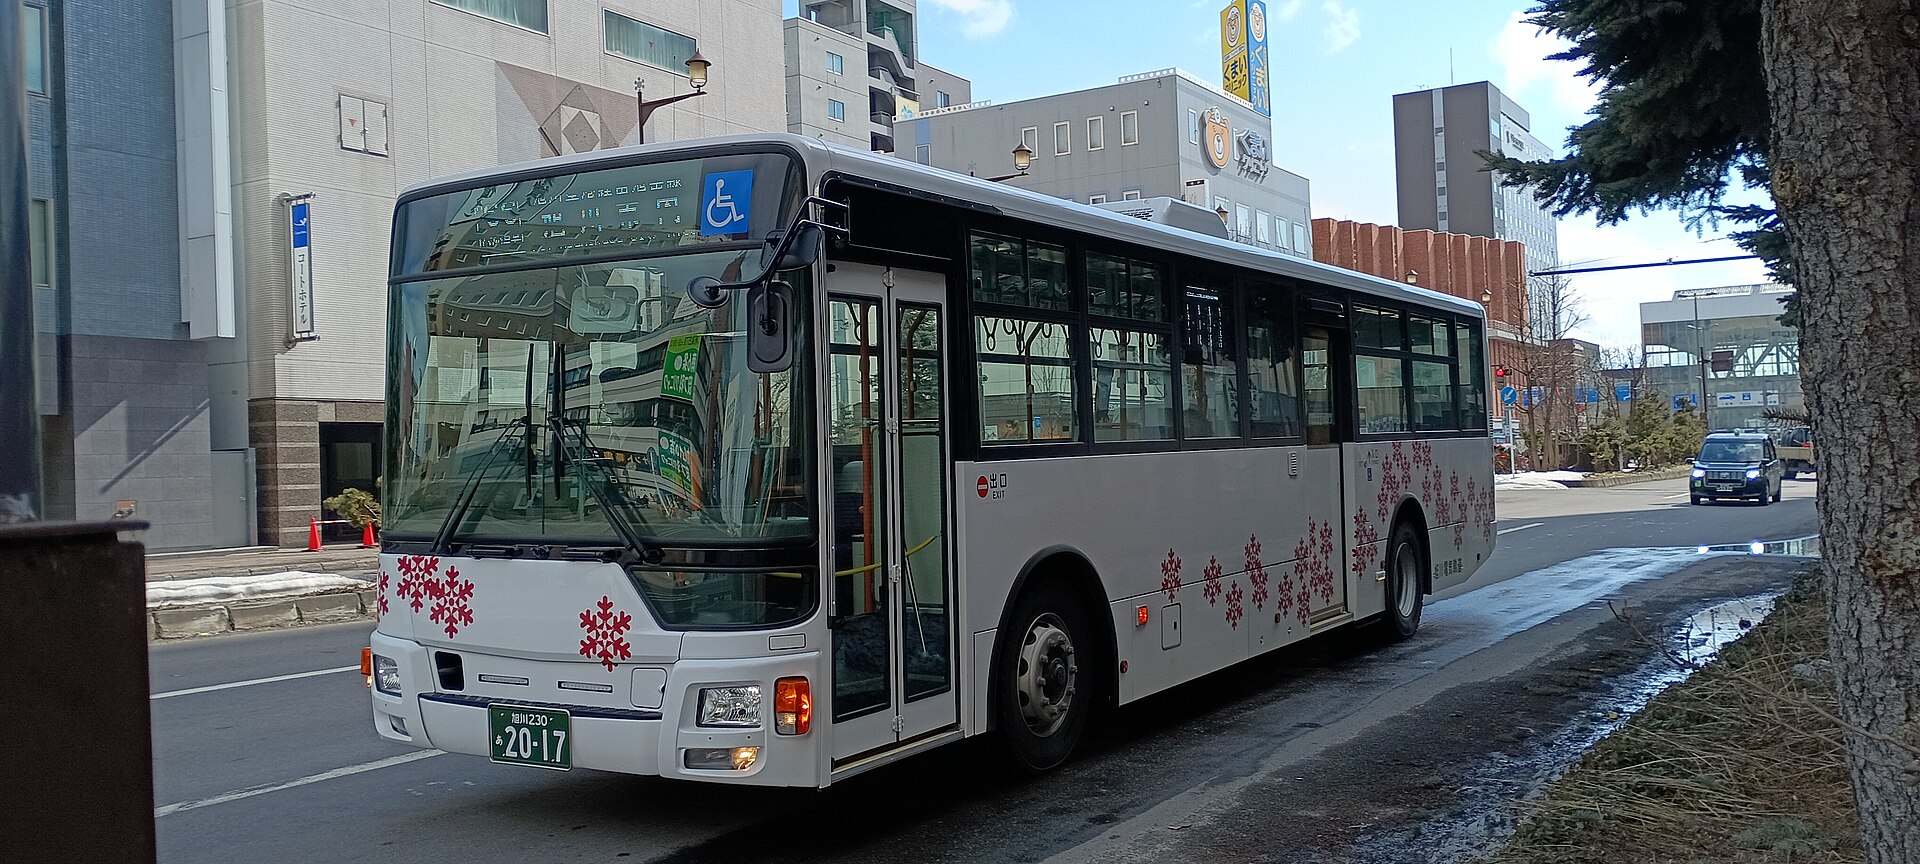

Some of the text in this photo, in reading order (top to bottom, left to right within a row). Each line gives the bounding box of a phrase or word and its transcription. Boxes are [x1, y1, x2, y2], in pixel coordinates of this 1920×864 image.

[1224, 54, 1247, 82] くまい
[1255, 45, 1266, 109] くまい
[298, 254, 308, 324] コートホテル
[989, 473, 1007, 488] 出口
[992, 491, 1005, 499] EXIT
[495, 725, 566, 763] あ 20-17
